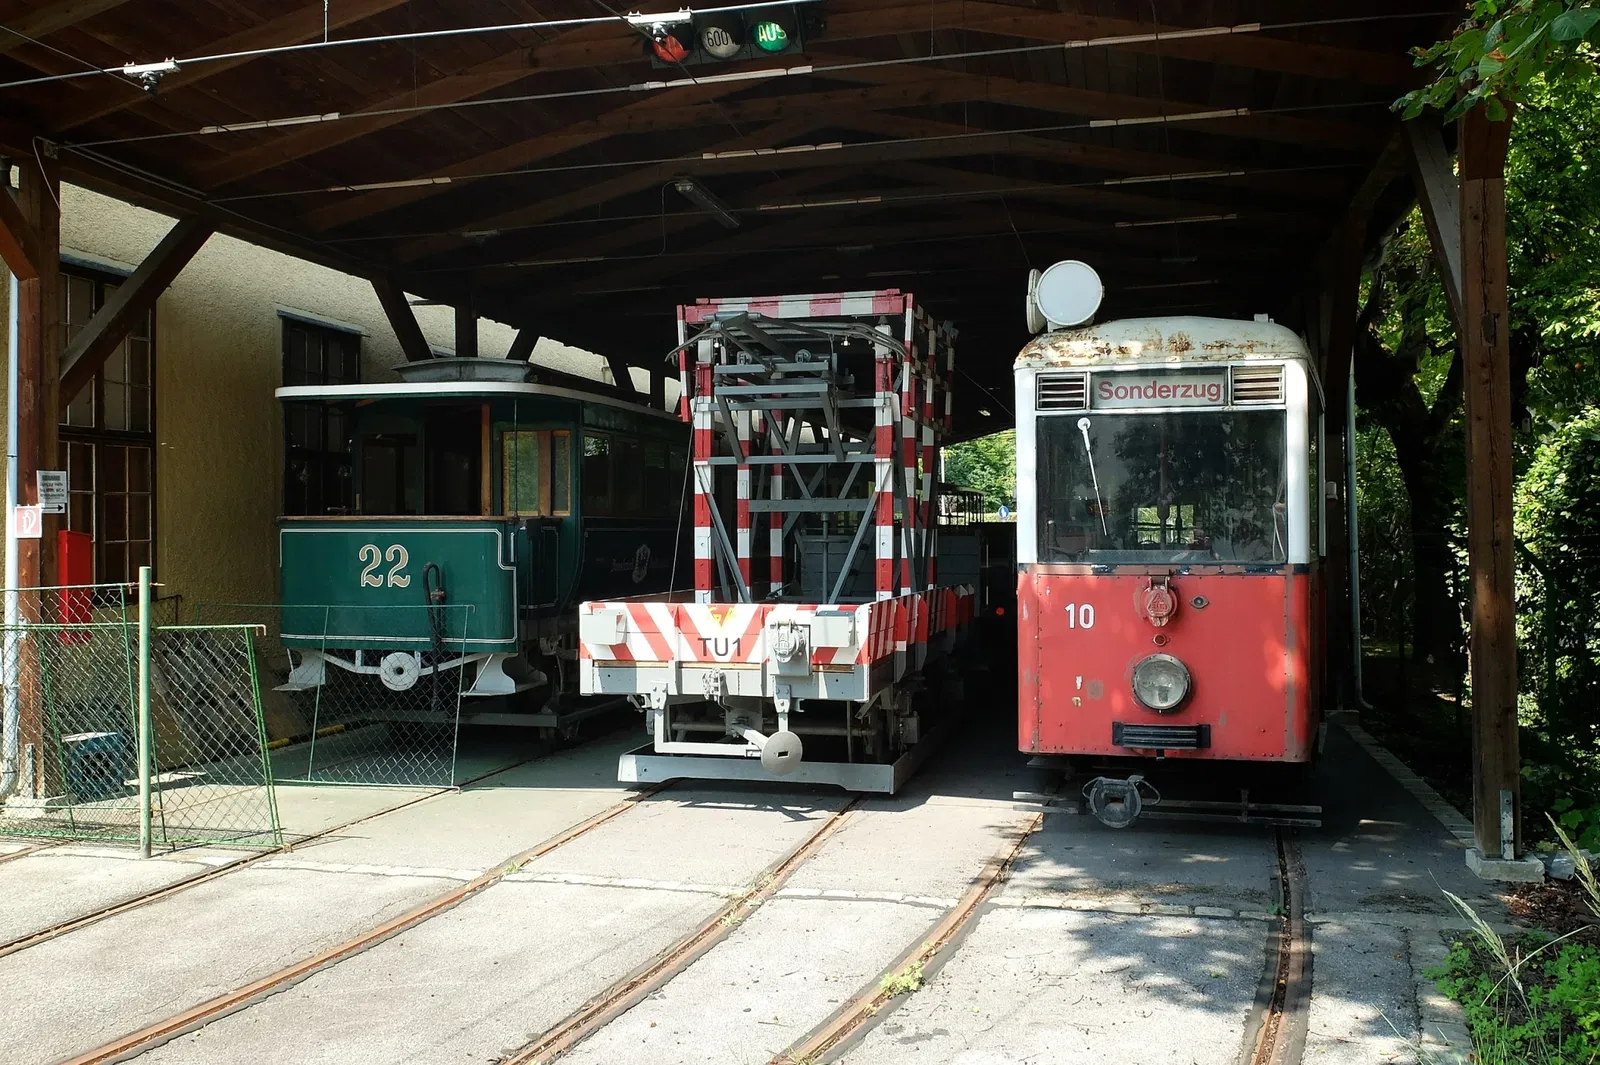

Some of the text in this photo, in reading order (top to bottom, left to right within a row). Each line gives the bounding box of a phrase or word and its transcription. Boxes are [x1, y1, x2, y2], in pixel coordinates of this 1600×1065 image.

[758, 23, 787, 42] AUS
[1098, 380, 1221, 402] Sonderzug
[359, 544, 411, 588] 22
[1064, 603, 1095, 629] 10
[697, 637, 741, 657] TU1
